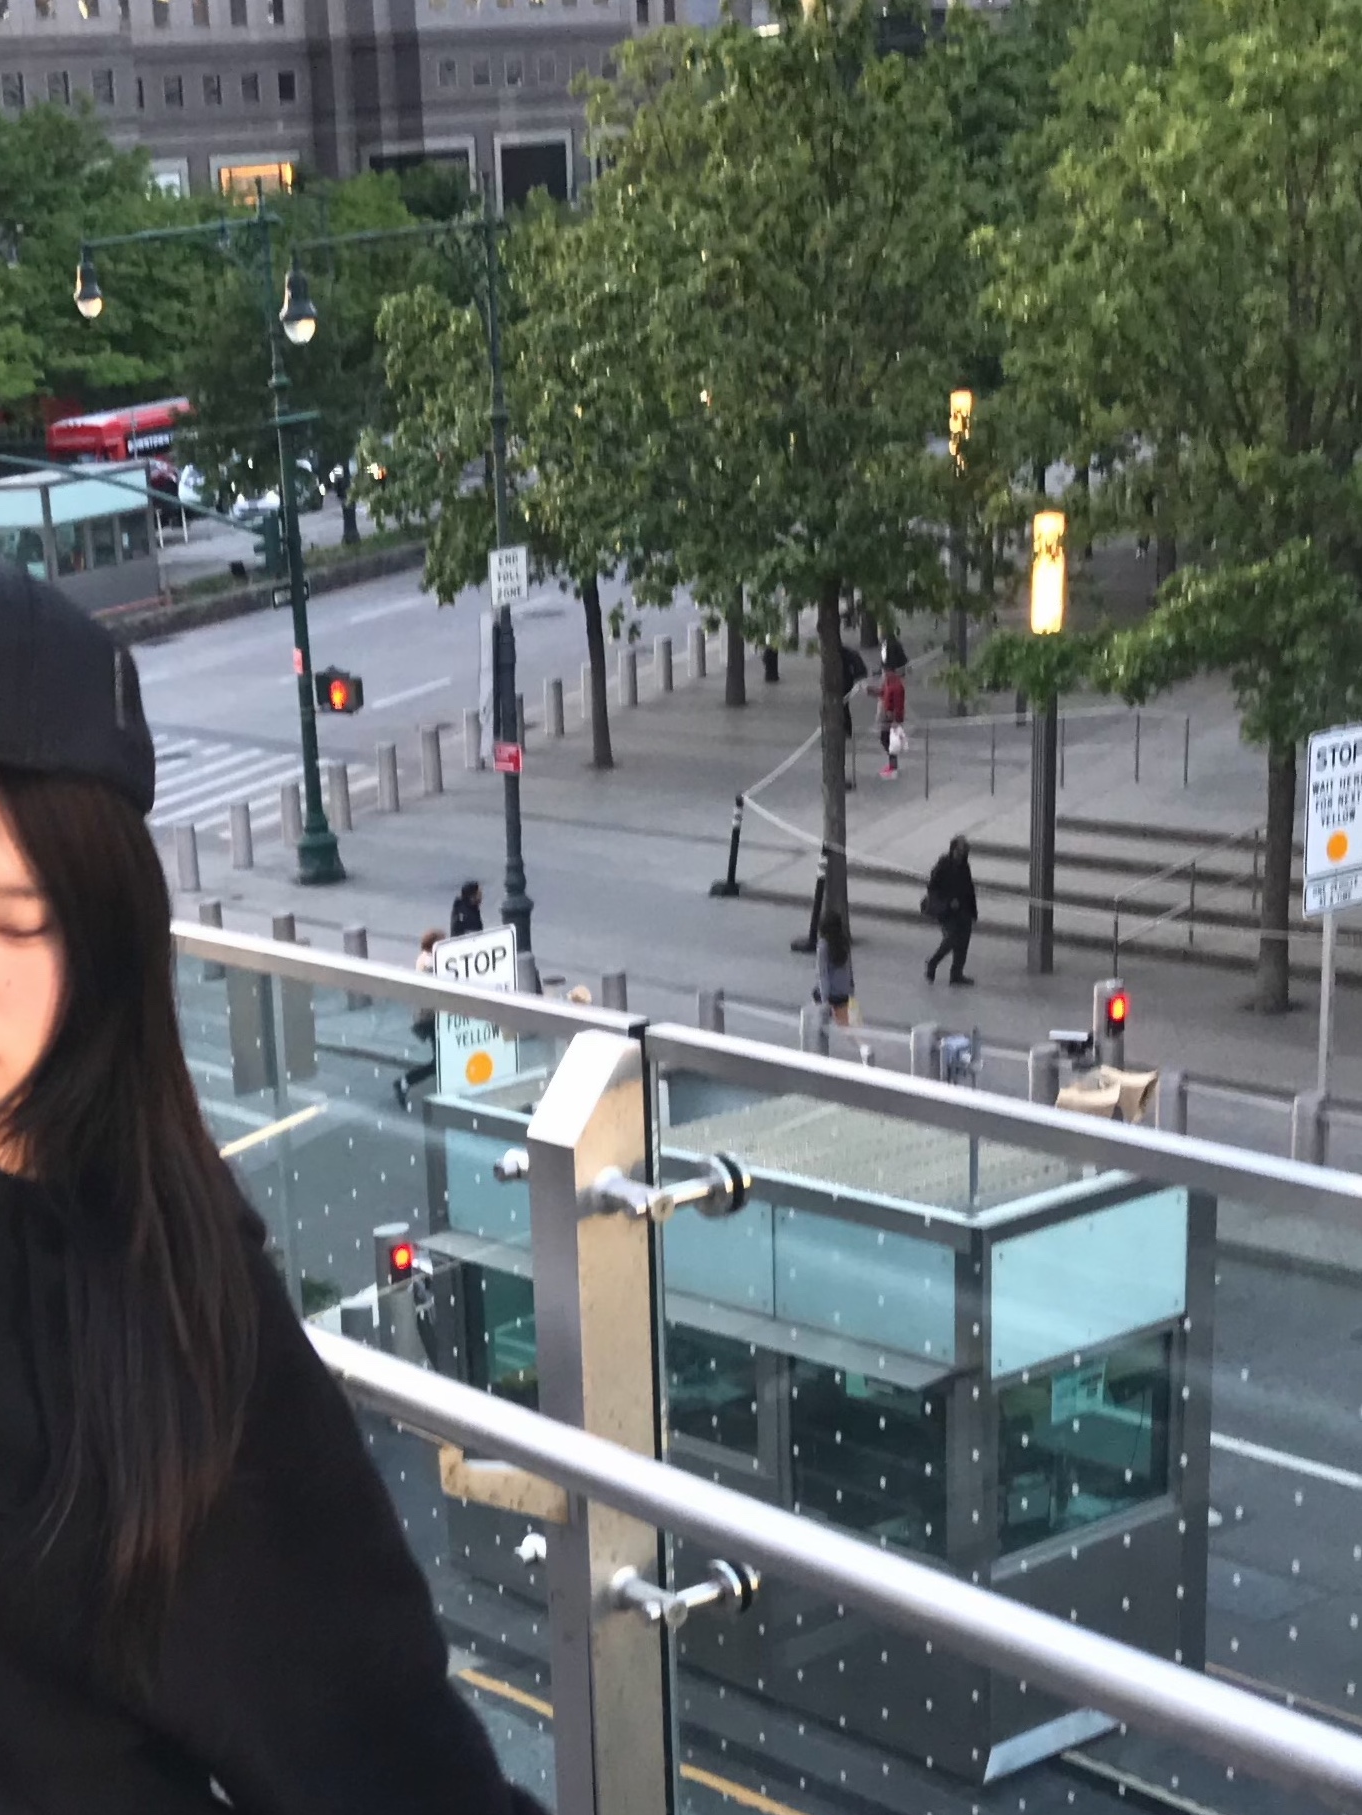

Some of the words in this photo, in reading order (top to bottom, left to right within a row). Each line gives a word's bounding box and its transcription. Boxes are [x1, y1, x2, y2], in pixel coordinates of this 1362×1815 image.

[1339, 772, 1362, 791] HER
[1321, 808, 1355, 828] YELLOW
[445, 945, 507, 981] STOP
[455, 1022, 500, 1048] YELLOW
